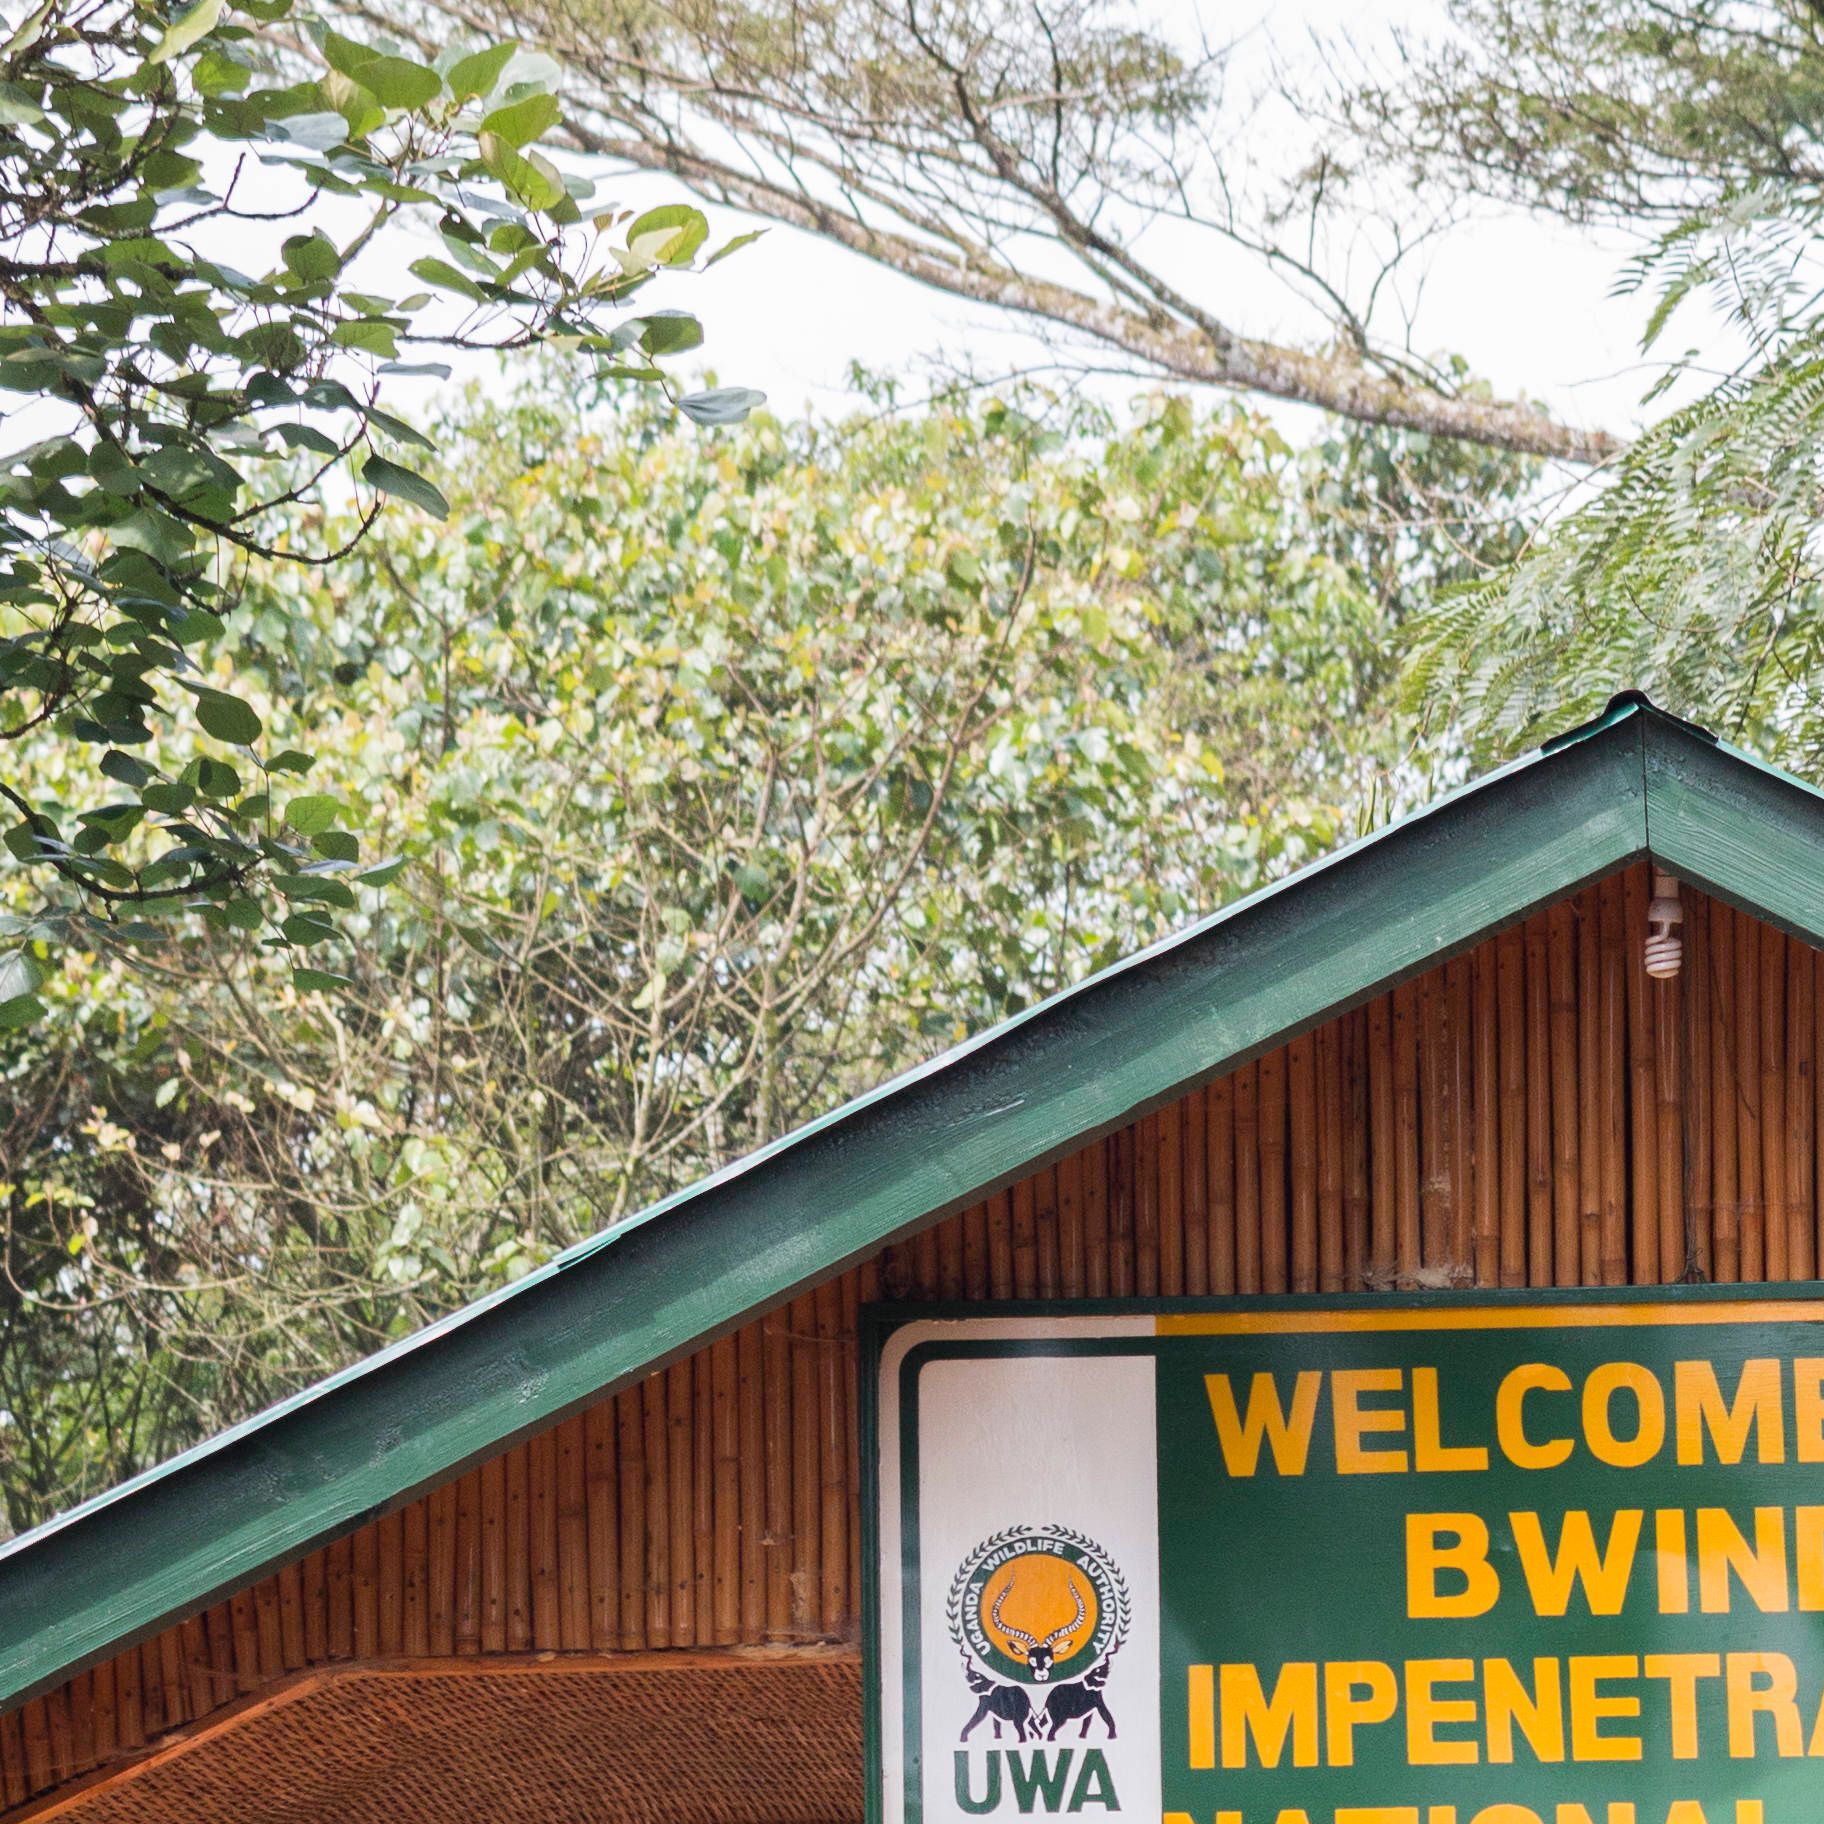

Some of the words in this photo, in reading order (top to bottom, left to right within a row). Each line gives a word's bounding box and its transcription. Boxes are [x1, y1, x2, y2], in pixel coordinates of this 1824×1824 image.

[965, 1581, 990, 1656] UGANDA
[982, 1539, 1066, 1573] WILDLIFE
[1076, 1556, 1117, 1656] AUTHORITY
[953, 1748, 1122, 1815] UWA
